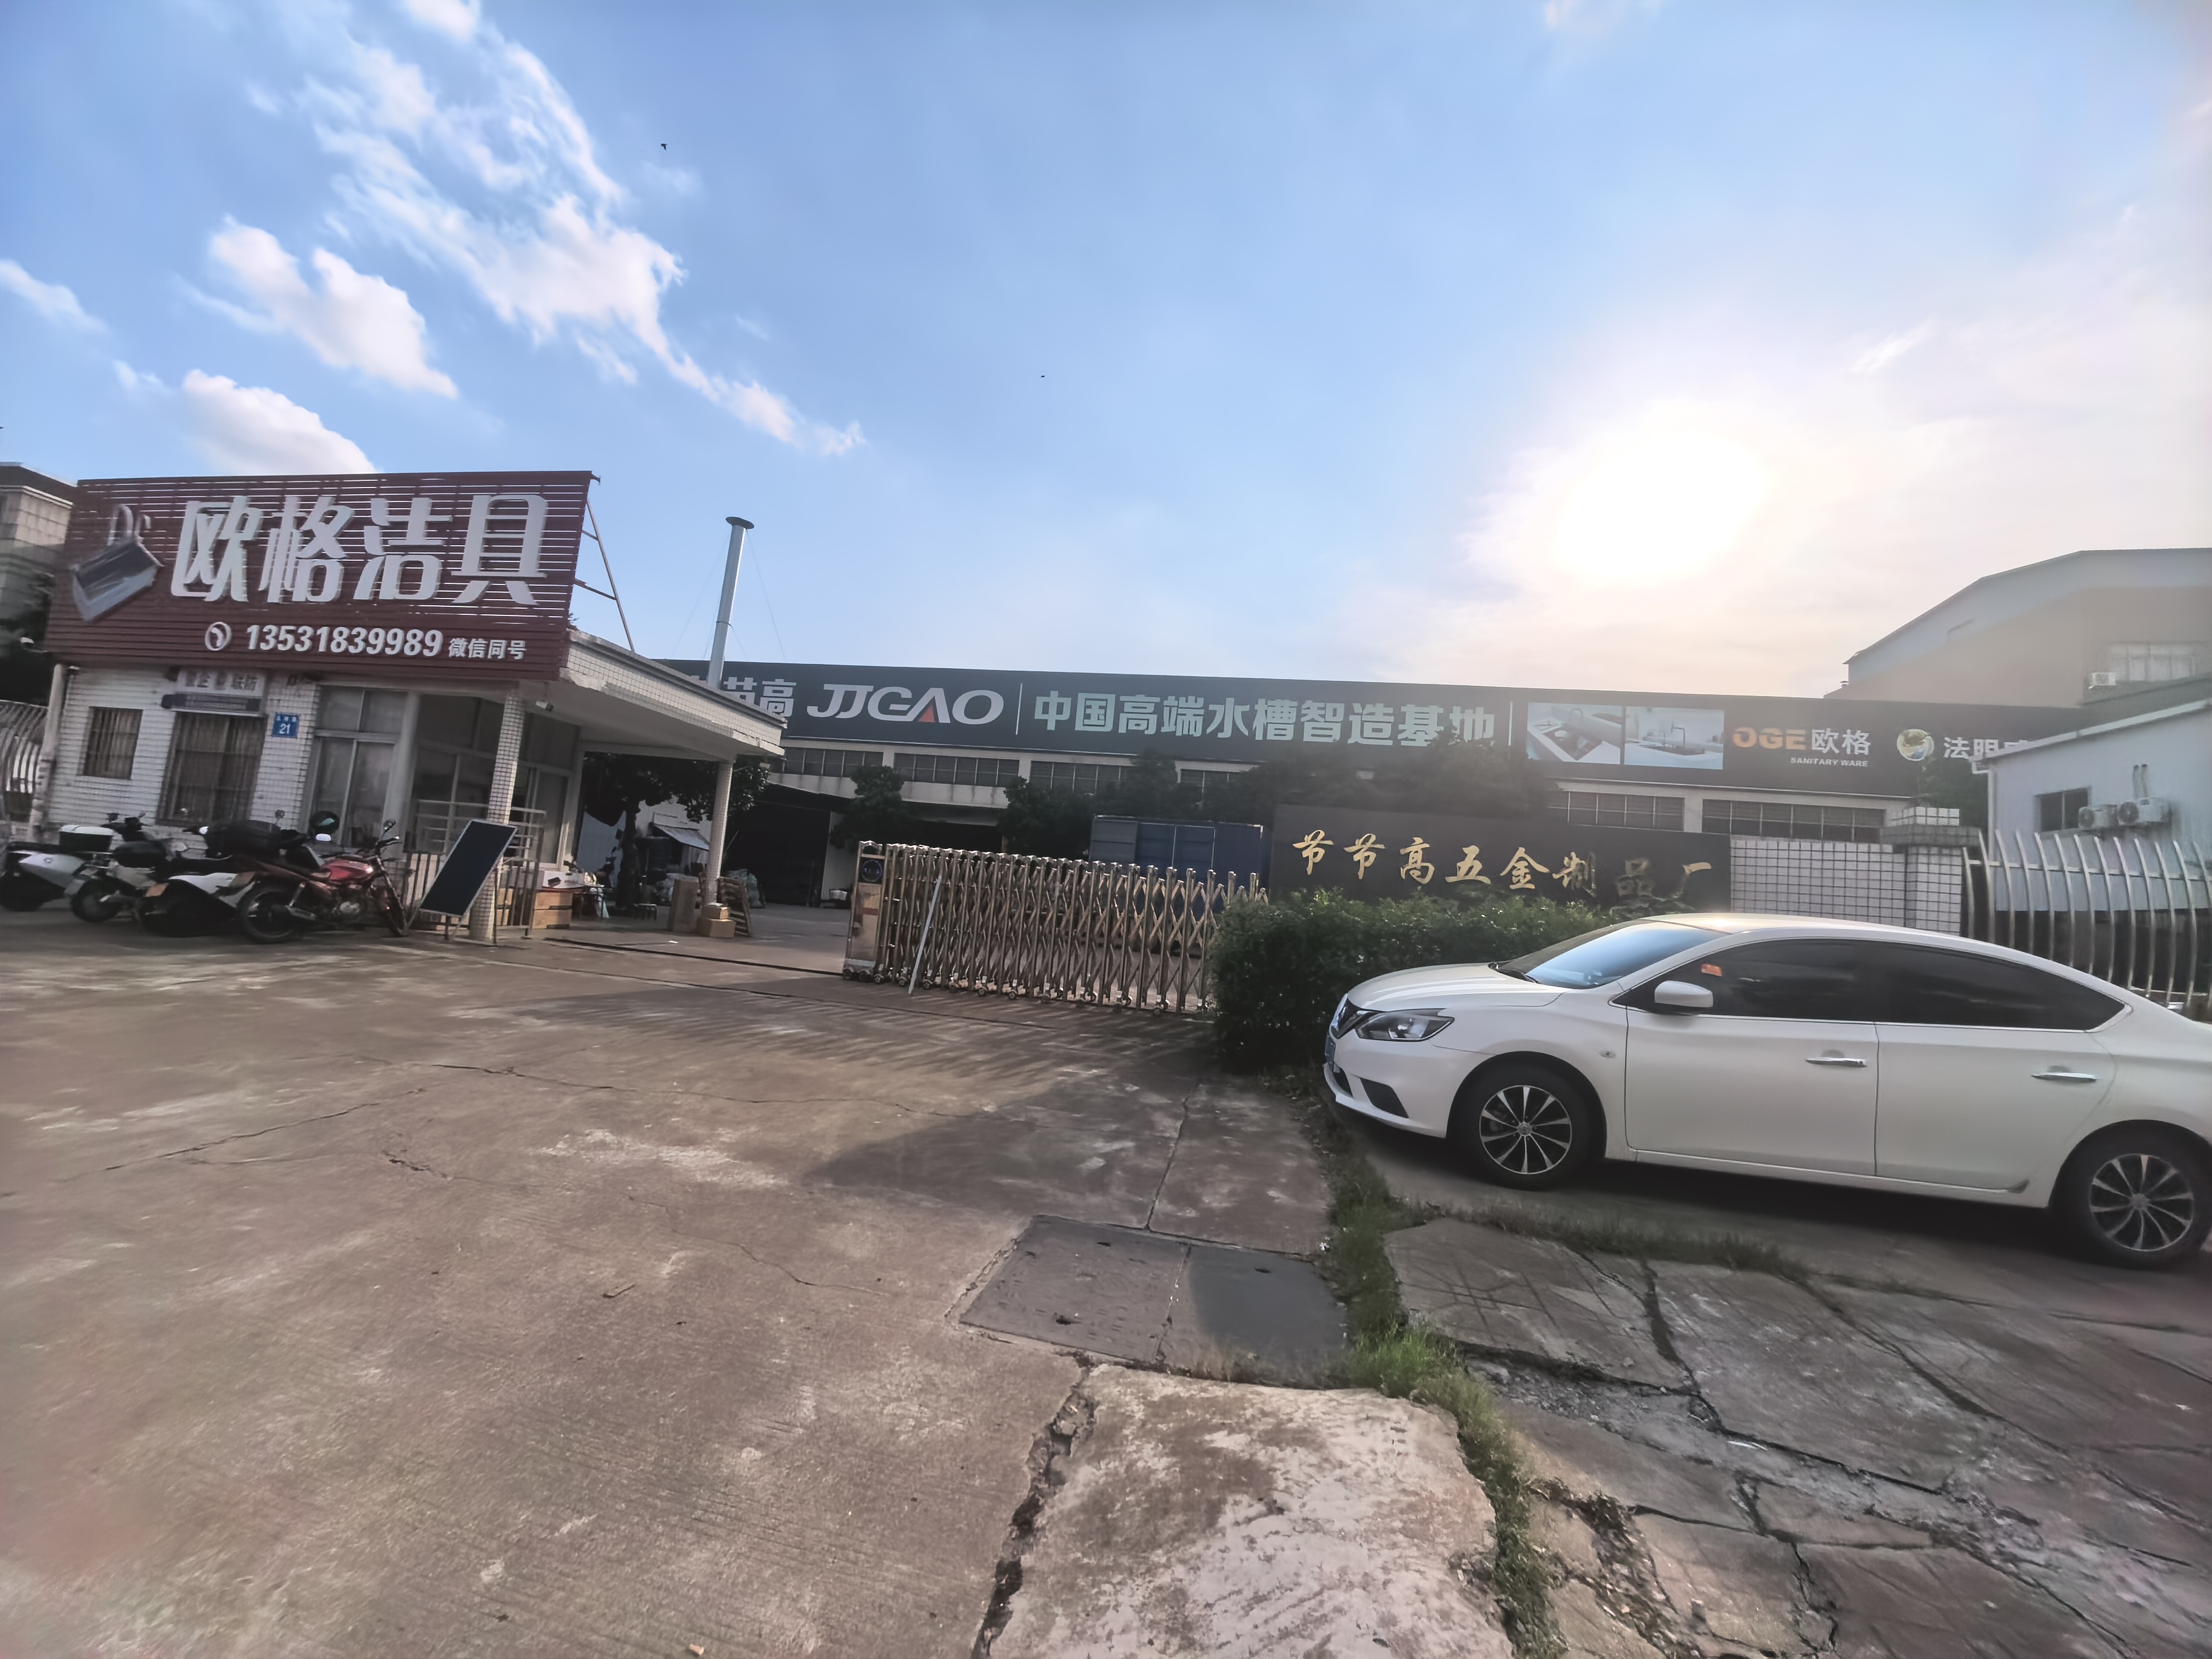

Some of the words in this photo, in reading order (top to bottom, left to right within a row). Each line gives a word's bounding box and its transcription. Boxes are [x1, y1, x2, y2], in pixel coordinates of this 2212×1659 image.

[170, 495, 549, 605] 欧格洁具
[246, 625, 444, 657] 13531839989
[447, 638, 528, 660] 微信同号
[691, 675, 797, 717] 节高
[806, 683, 1004, 725] JJGAO
[1033, 690, 1496, 746] 中国高端水槽智造基地
[279, 723, 291, 734] 21
[1732, 726, 1806, 749] OGE
[1811, 728, 1871, 755] 欧格
[1790, 757, 1838, 766] SANITARY
